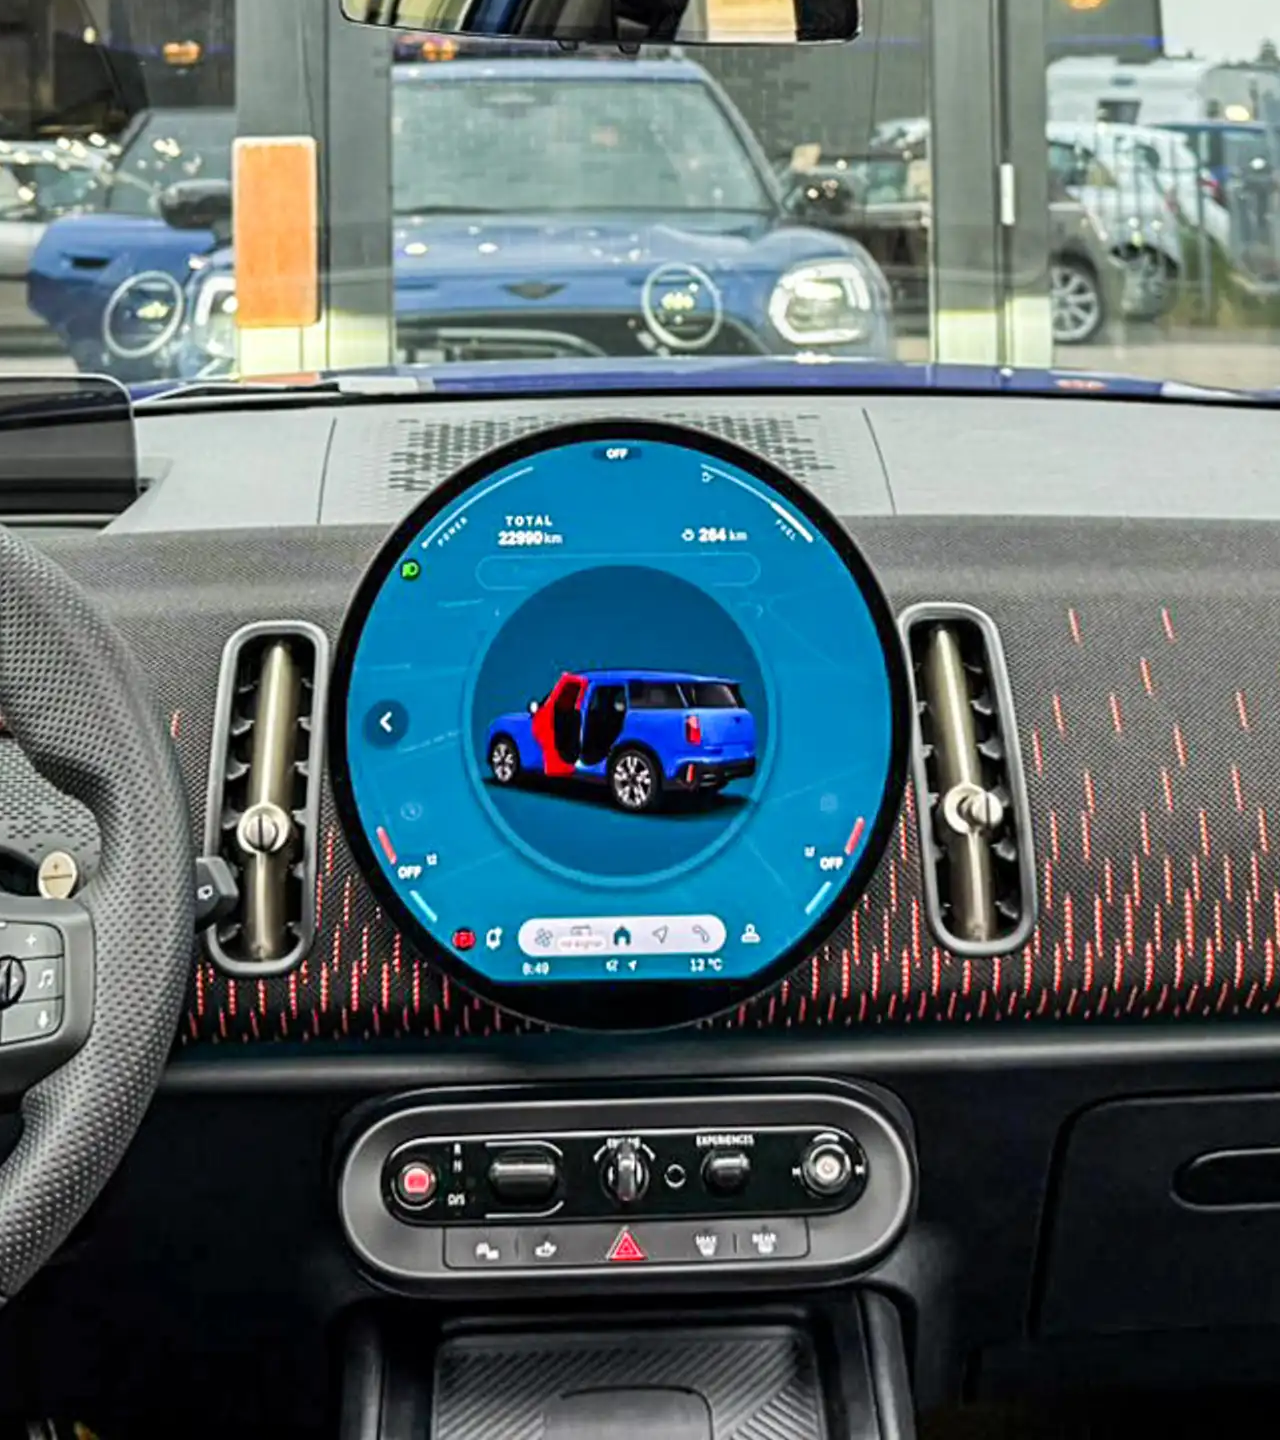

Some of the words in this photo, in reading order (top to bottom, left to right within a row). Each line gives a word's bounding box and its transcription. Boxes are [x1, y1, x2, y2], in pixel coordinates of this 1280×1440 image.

[606, 448, 629, 460] OFF
[505, 515, 553, 527] TOTAL
[729, 528, 748, 541] km
[775, 518, 797, 542] FUEL
[819, 856, 844, 871] OFF
[397, 865, 422, 880] OFF
[696, 1134, 754, 1147] EXPERIENCES
